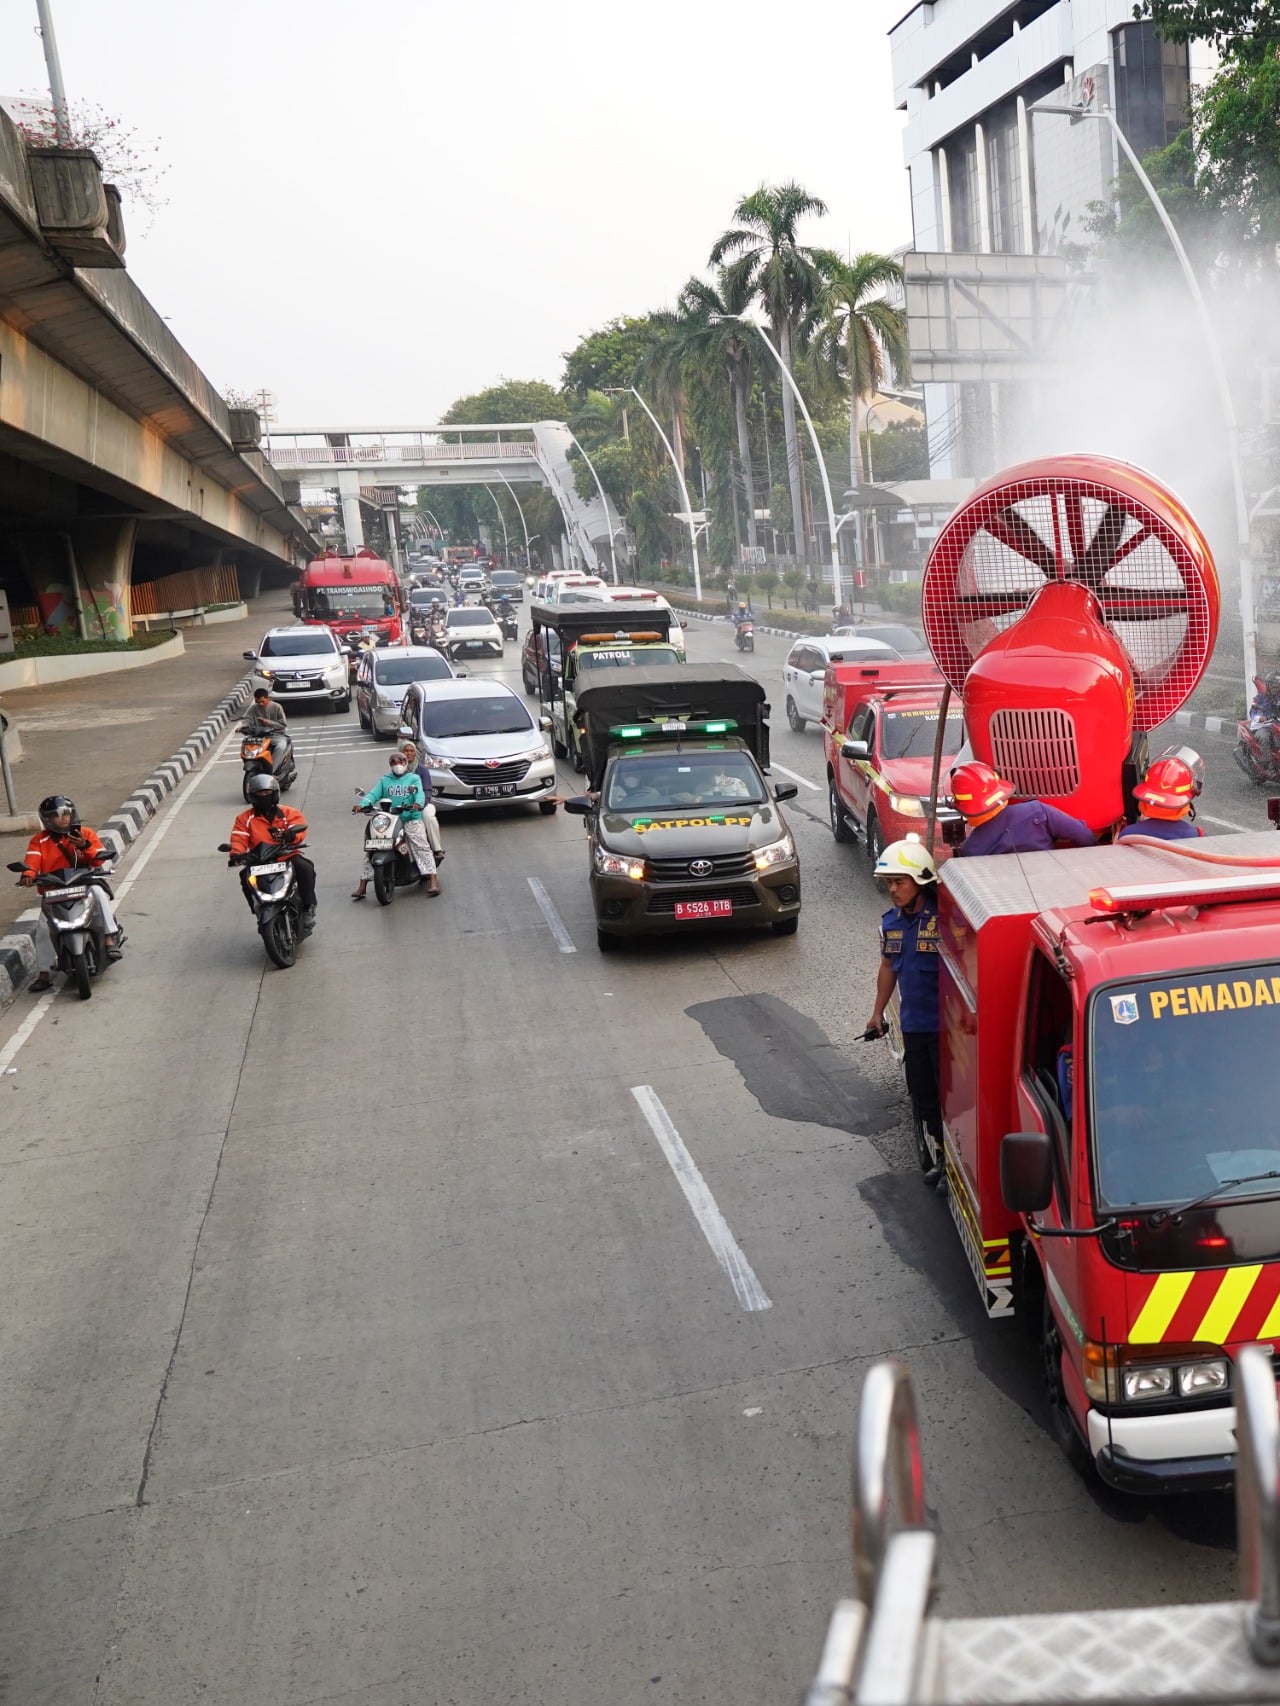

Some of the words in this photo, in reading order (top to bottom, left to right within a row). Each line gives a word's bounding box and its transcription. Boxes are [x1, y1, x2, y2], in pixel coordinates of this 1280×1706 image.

[593, 651, 630, 660] PATROLI
[633, 818, 718, 833] SATPOL
[722, 817, 752, 827] PP
[677, 904, 683, 914] B
